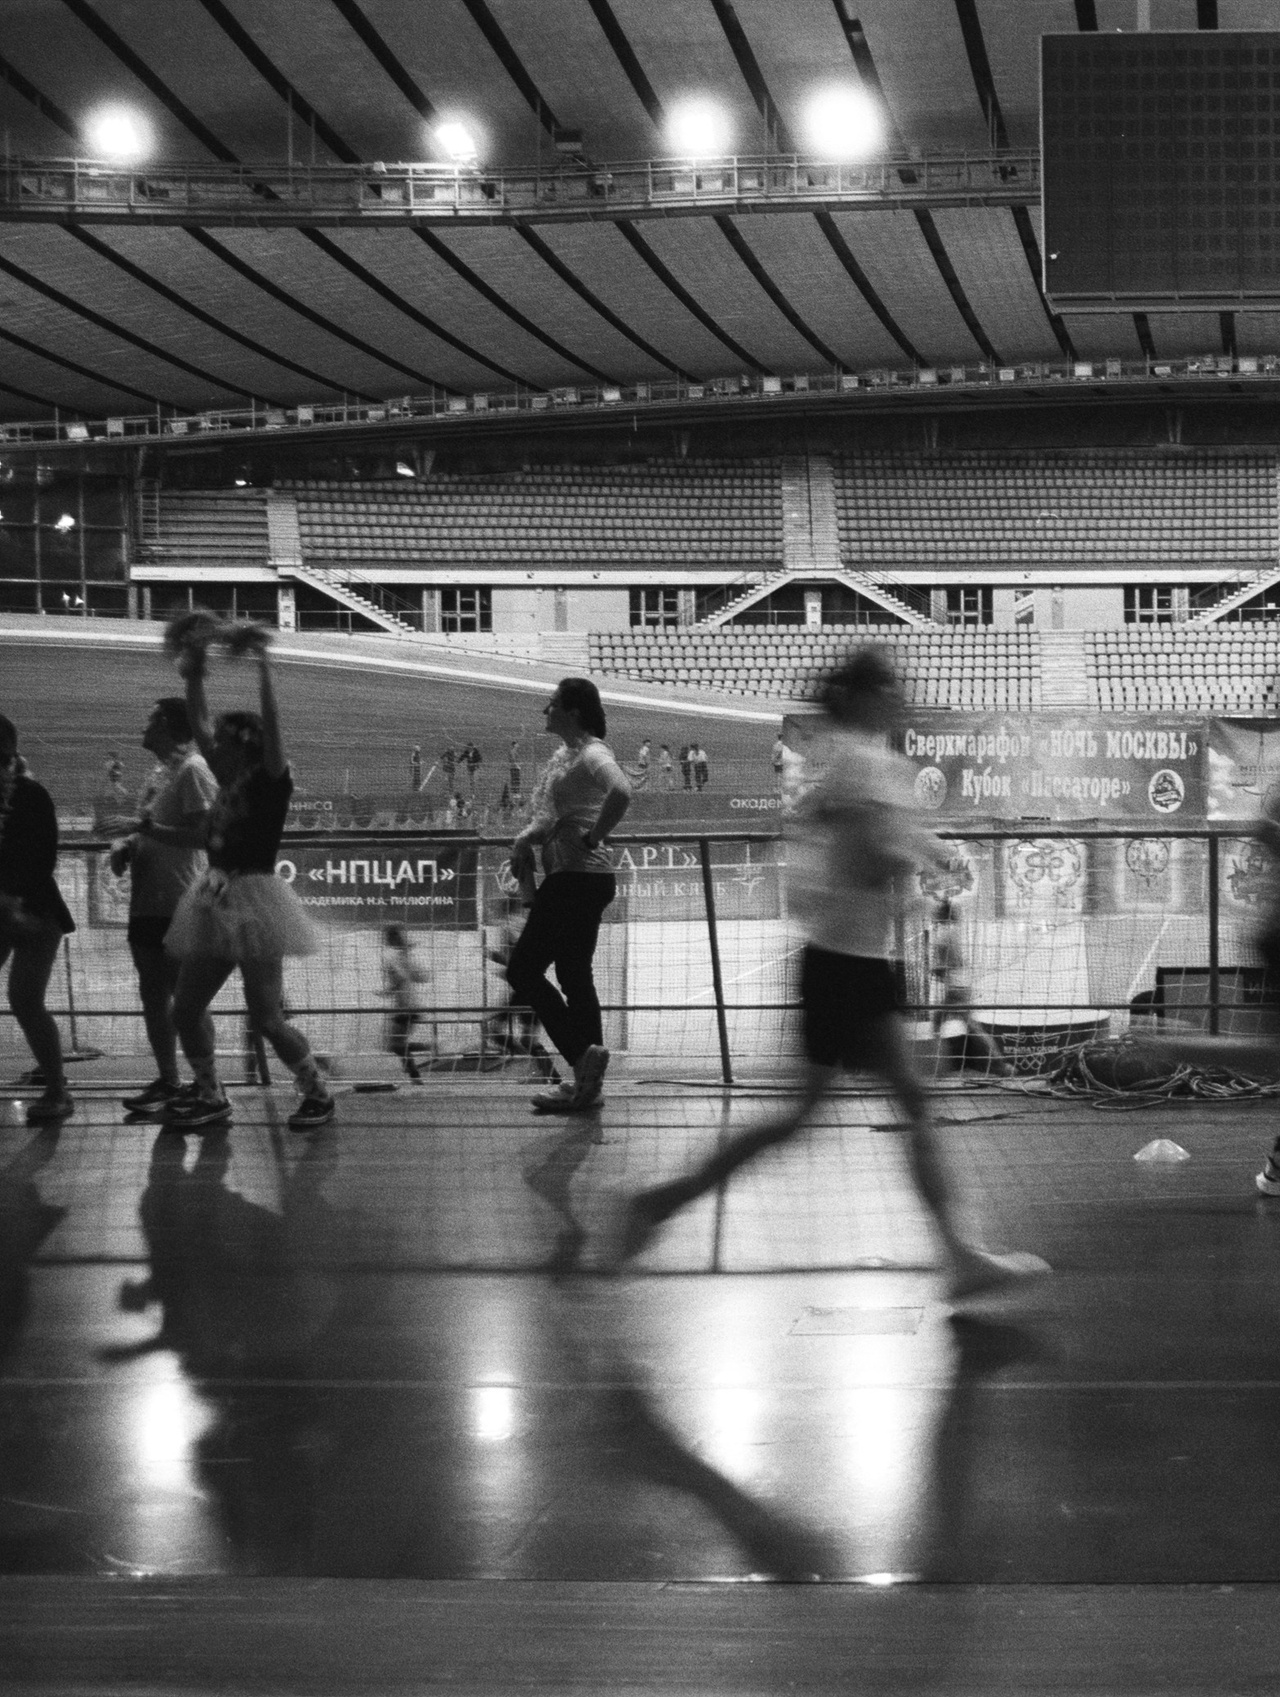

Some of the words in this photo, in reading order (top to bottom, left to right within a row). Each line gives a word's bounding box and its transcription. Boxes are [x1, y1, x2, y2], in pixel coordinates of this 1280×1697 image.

[905, 726, 1030, 763] Сверхмарафон
[1105, 730, 1197, 760] МОСКВЫ»
[961, 766, 1012, 805] Кубок
[308, 859, 456, 889] «НПЦАП»
[390, 896, 454, 906] ПИЛЮГИНА
[674, 881, 727, 898] КЛБ
